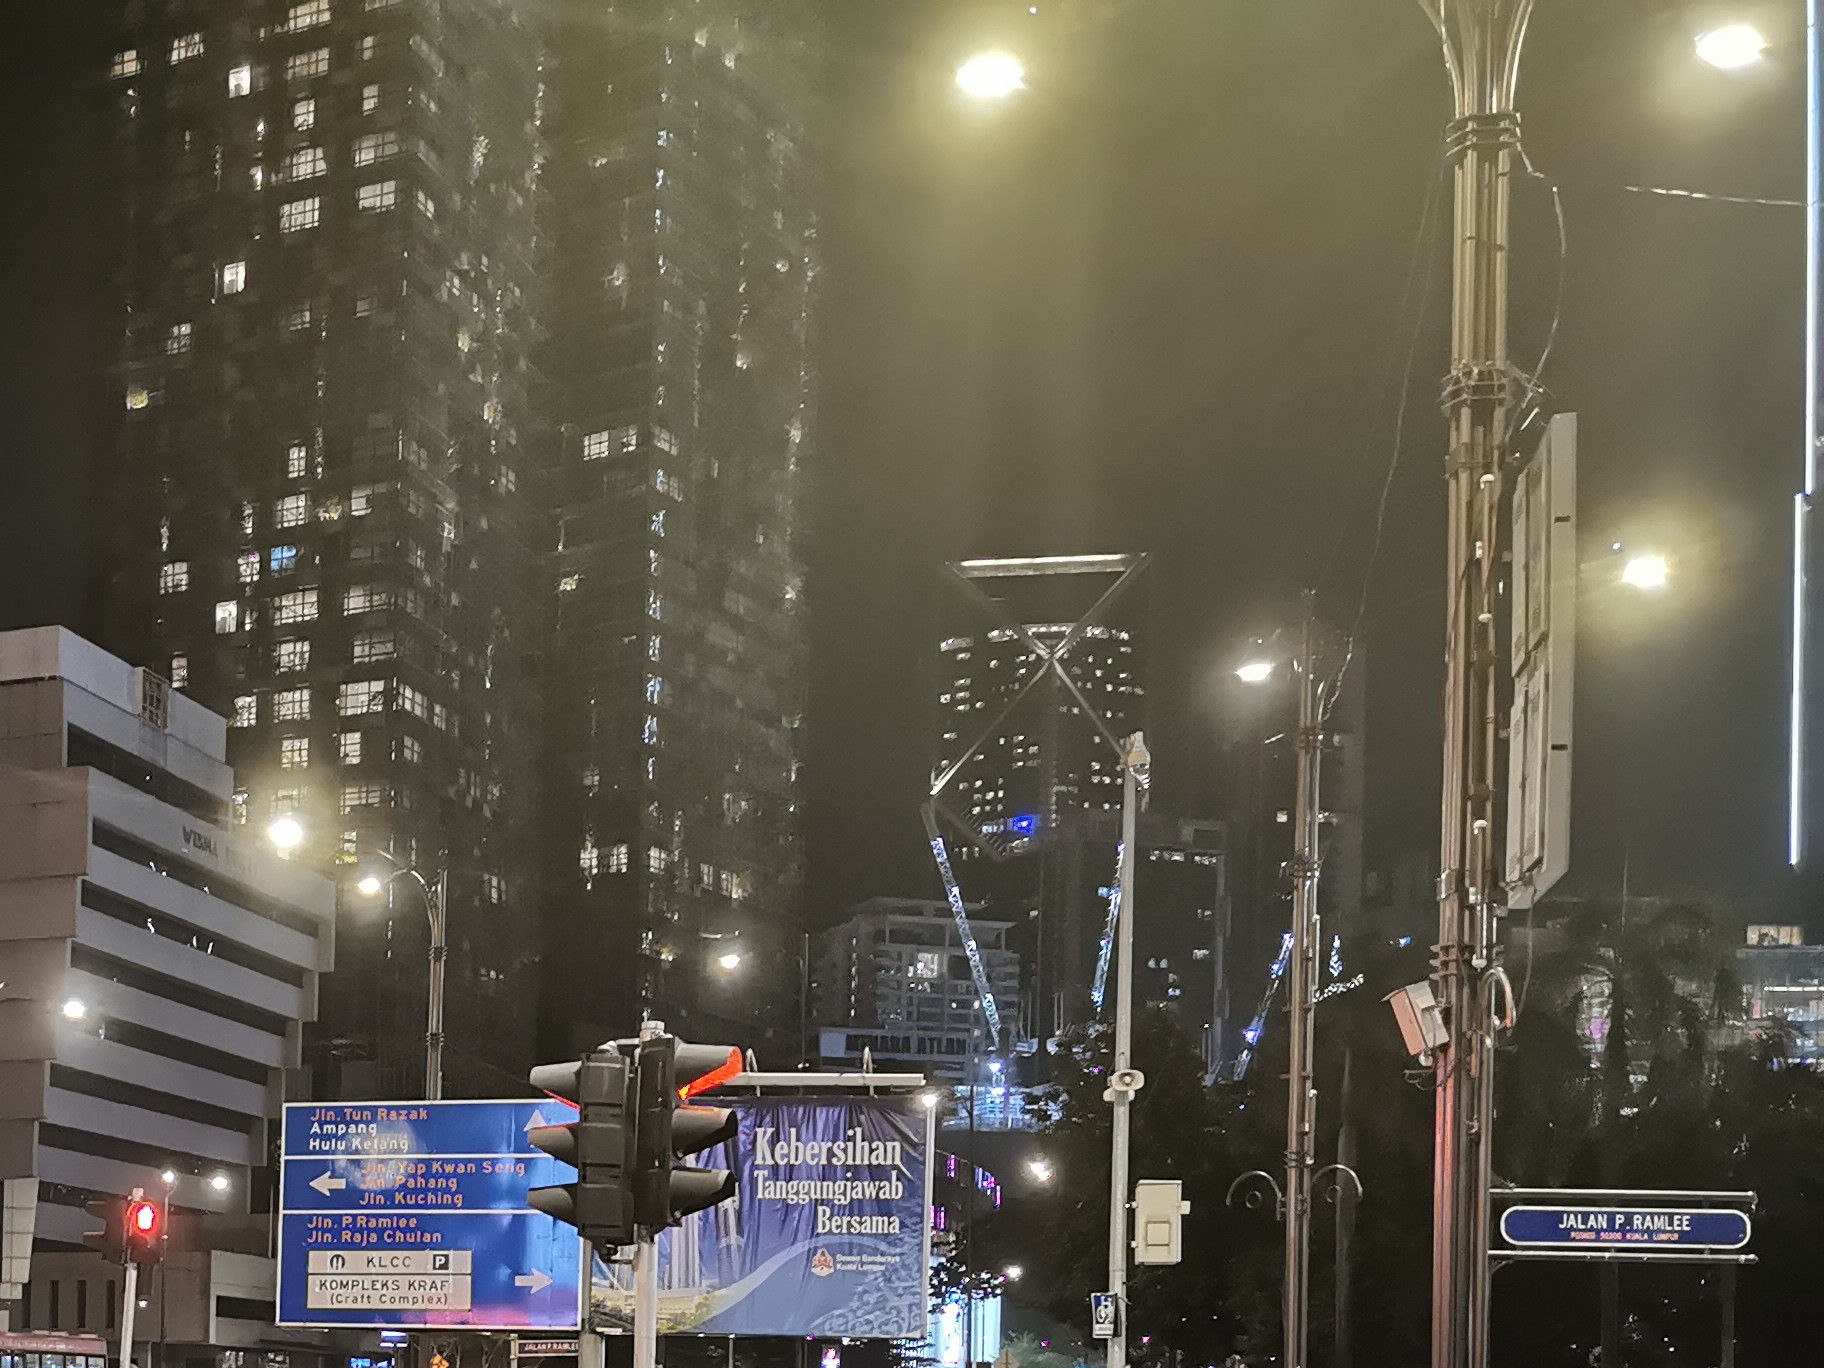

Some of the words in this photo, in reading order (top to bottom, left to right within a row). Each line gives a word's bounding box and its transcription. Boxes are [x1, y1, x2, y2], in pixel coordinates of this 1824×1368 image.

[310, 1109, 341, 1122] Jln.
[344, 1109, 372, 1121] Tun
[377, 1108, 428, 1121] Razak
[310, 1122, 377, 1137] Ampang
[309, 1138, 346, 1151] Hulu
[351, 1138, 409, 1152] Kelang
[753, 1126, 902, 1166] Kebersihan
[397, 1161, 426, 1175] Yap
[432, 1161, 476, 1174] Kwan
[482, 1161, 525, 1177] Seng
[394, 1176, 458, 1191] Pahang
[753, 1170, 904, 1205] Tanggungjawab
[359, 1192, 390, 1205] Jln.
[394, 1192, 463, 1207] Kuching
[307, 1216, 338, 1229] Jln.
[816, 1205, 901, 1234] Bersama
[1559, 1213, 1607, 1230] JALAN
[307, 1230, 338, 1243] Jln.
[341, 1230, 377, 1246] Raja
[383, 1230, 442, 1243] Chulan
[366, 1256, 412, 1268] KLCC
[318, 1279, 401, 1292] KOMPLEKS
[407, 1279, 451, 1292] KRAF
[329, 1293, 373, 1306] (Craft
[378, 1293, 448, 1307] Complex)
